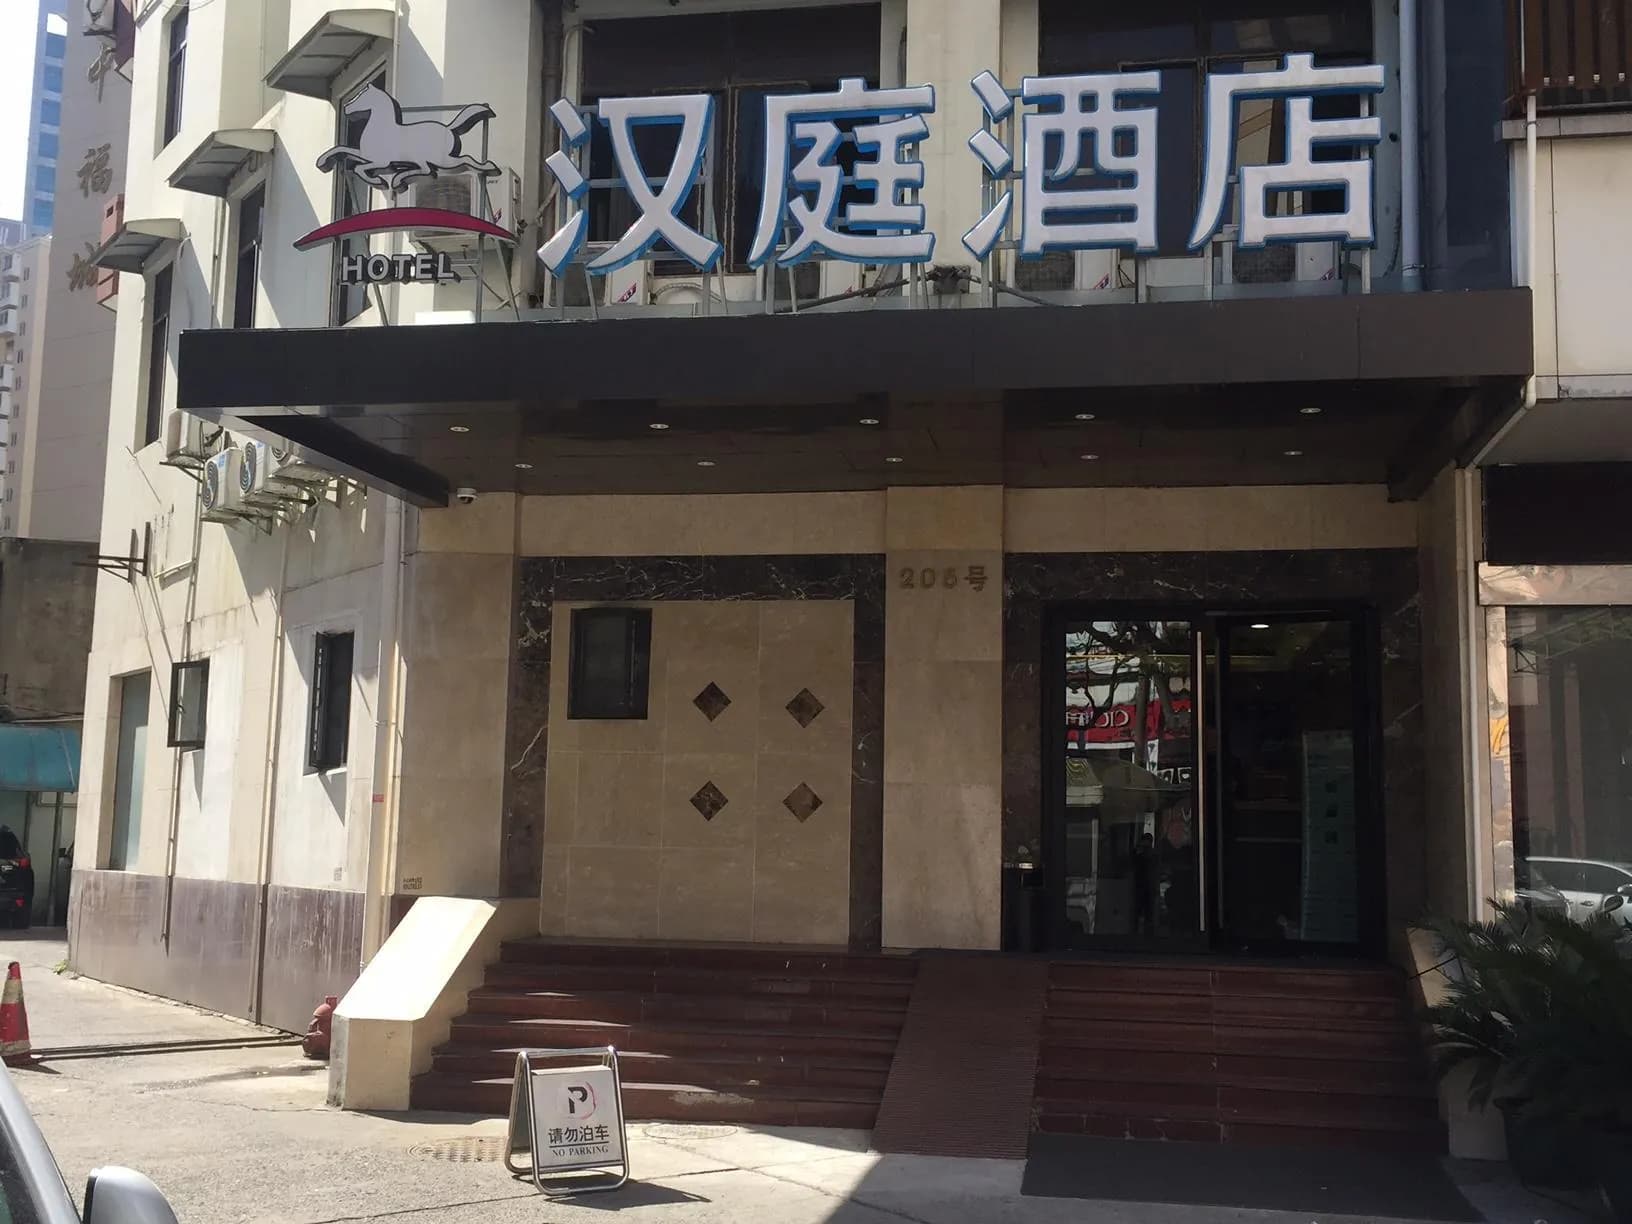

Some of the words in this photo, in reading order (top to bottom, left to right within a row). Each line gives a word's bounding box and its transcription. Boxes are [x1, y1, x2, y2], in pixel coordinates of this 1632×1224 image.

[537, 53, 1386, 273] 汉庭酒店
[342, 253, 457, 282] HOTEL
[548, 1124, 609, 1144] 请勿泊车
[552, 1149, 565, 1157] NO
[569, 1145, 609, 1156] PARKING
